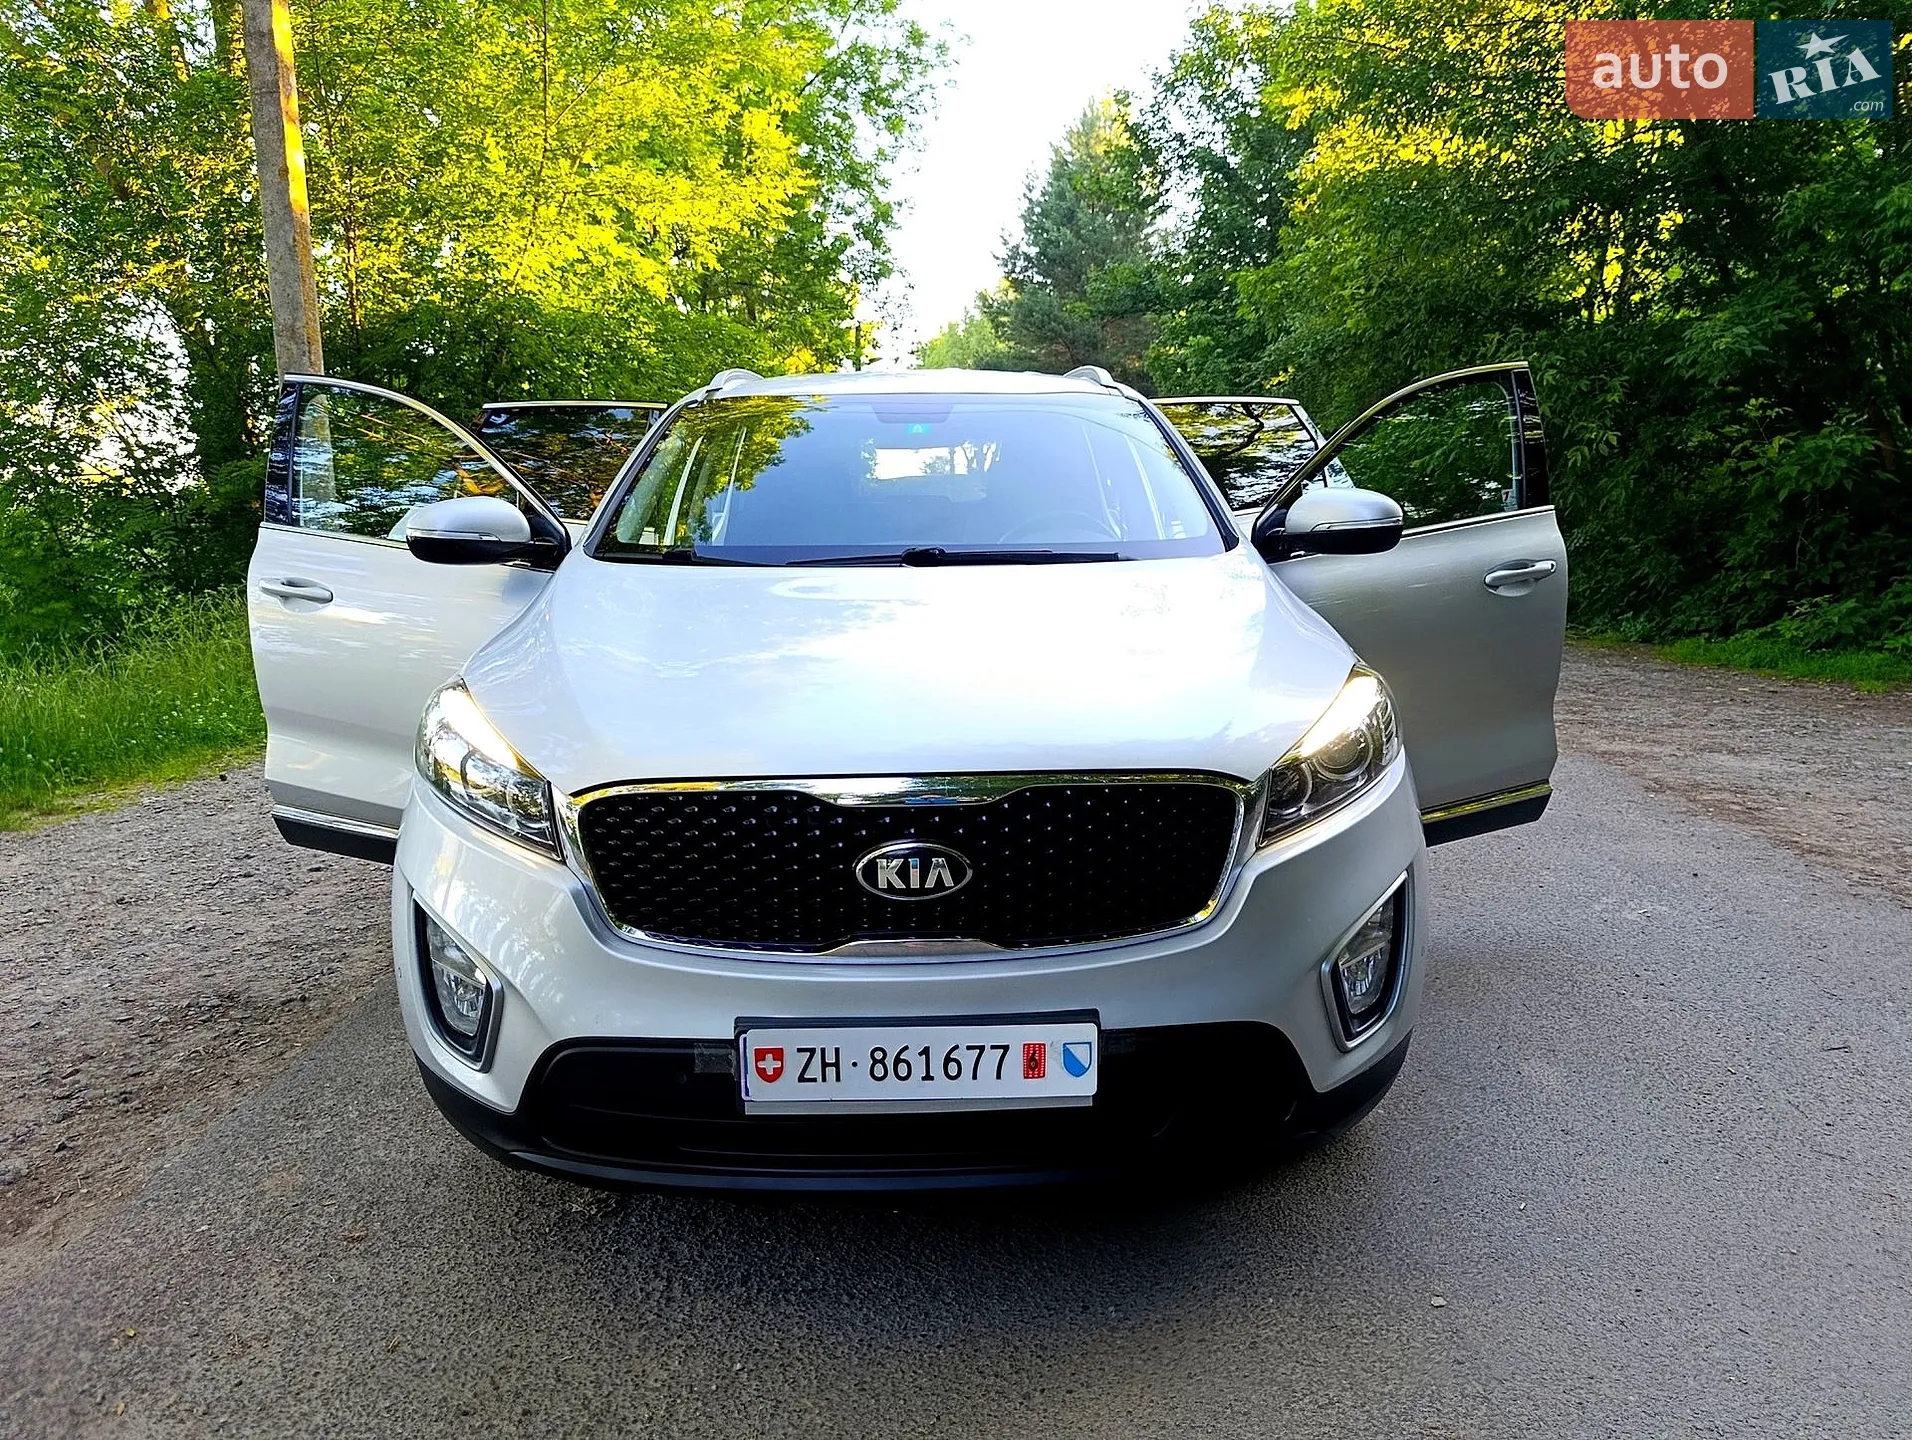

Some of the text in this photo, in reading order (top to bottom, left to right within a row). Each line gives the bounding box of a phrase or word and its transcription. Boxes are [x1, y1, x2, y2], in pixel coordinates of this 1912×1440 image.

[876, 857, 955, 889] KIA
[796, 1043, 1011, 1083] ZH 861677
